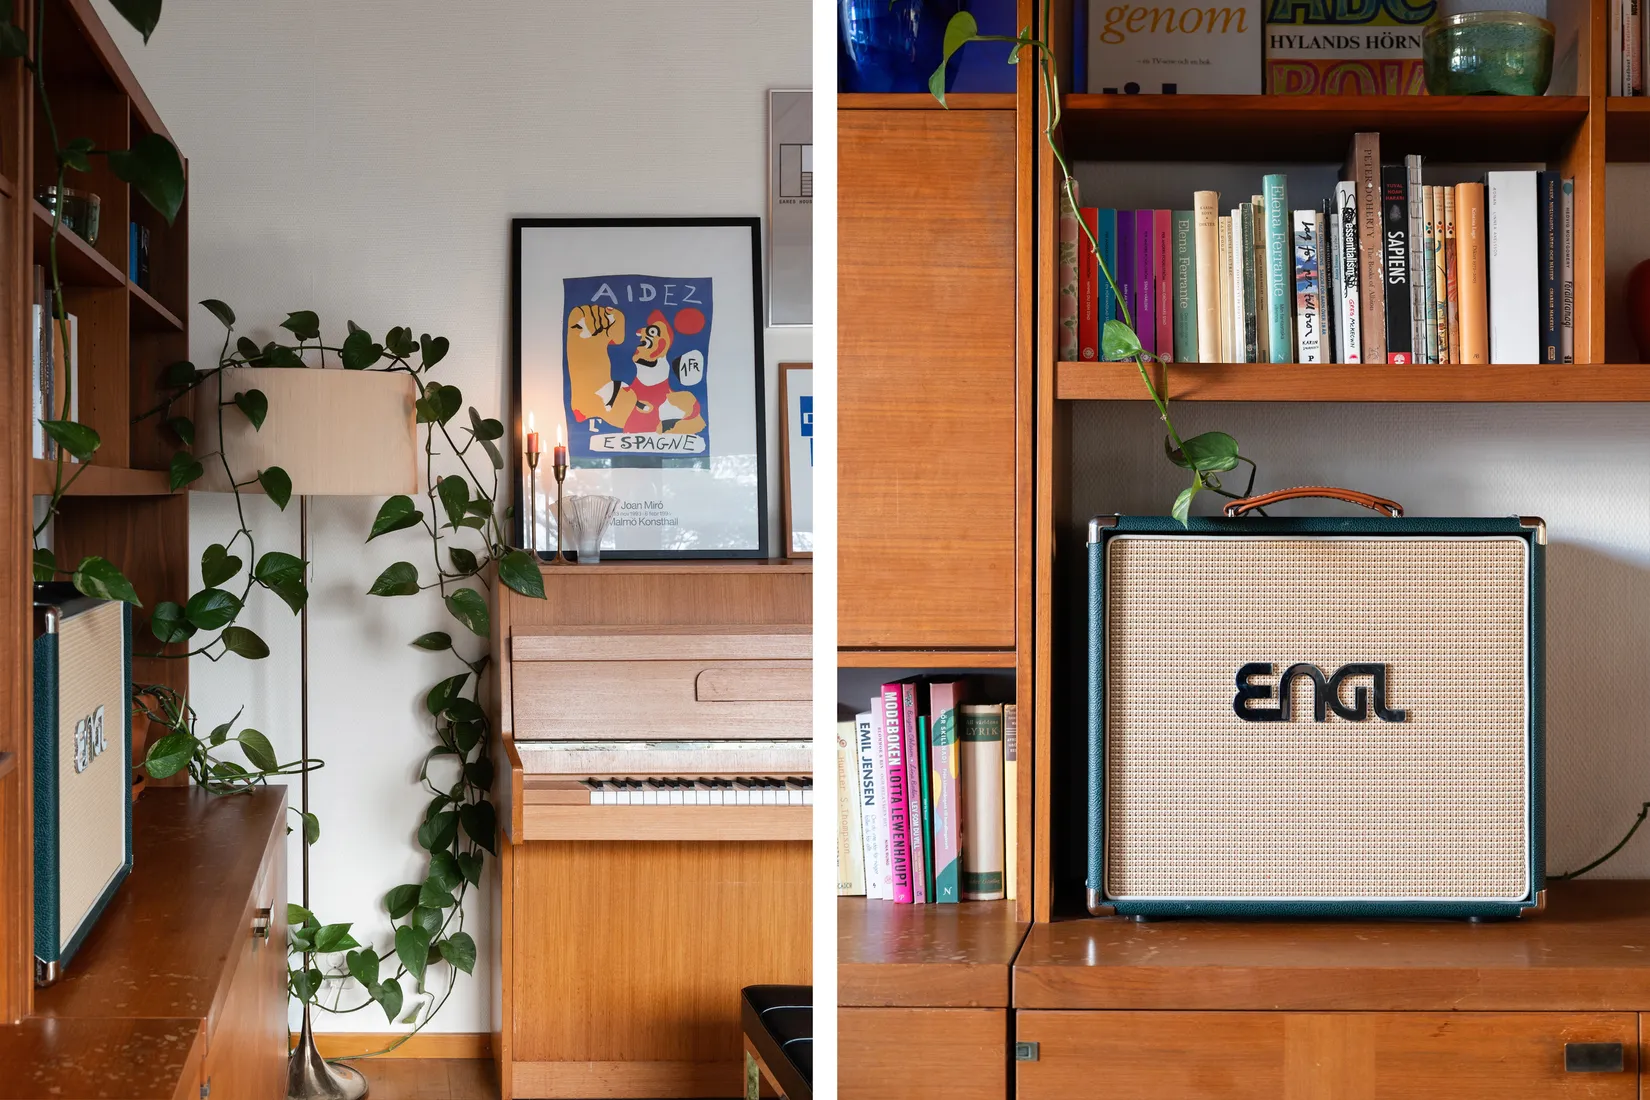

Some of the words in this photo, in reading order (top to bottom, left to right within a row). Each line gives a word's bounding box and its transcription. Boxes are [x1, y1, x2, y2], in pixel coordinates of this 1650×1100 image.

[1100, 5, 1249, 44] genom
[1270, 35, 1360, 49] HYLANDS
[1152, 57, 1177, 65] TV-serie
[1178, 57, 1189, 65] och
[1364, 149, 1374, 183] PETER
[1271, 184, 1285, 228] Elena
[1365, 186, 1376, 239] DOHERTY
[1179, 219, 1190, 252] Elena
[1346, 223, 1356, 275] essentialism
[1272, 232, 1286, 297] Ferrante
[1388, 231, 1405, 285] SAPIENS
[592, 282, 703, 305] AIDEZ
[1180, 257, 1190, 308] Ferrante
[1561, 281, 1573, 329] Föräldramagi
[604, 434, 698, 450] ESPAGNE
[611, 517, 638, 526] Malmö
[638, 517, 679, 526] Konsthall
[621, 501, 643, 510] Joan
[644, 501, 664, 510] Miró
[1233, 662, 1406, 722] ENGL
[860, 722, 871, 752] EMIL
[884, 692, 901, 766] MODEBOKEN
[966, 728, 999, 736] LYRIK
[862, 756, 875, 806] JENSEN
[889, 769, 904, 803] LOTTA
[891, 808, 907, 888] LEWENHAUPT
[913, 828, 919, 836] DU
